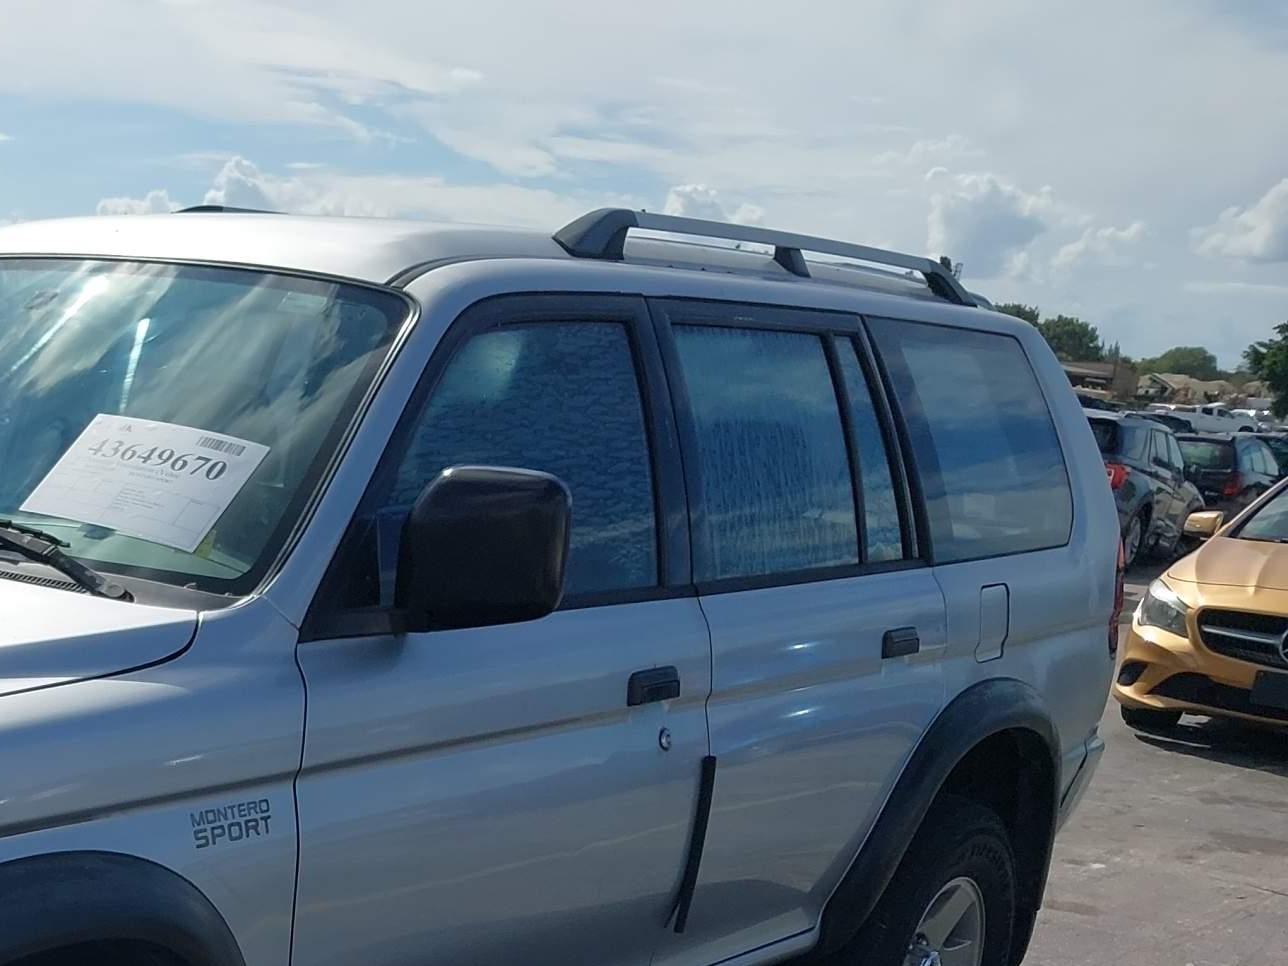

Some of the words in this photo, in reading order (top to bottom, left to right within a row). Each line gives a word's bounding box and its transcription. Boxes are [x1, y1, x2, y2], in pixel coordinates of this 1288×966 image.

[88, 438, 229, 481] 43649670
[190, 798, 271, 828] MONTERO
[193, 815, 272, 849] SPORT
